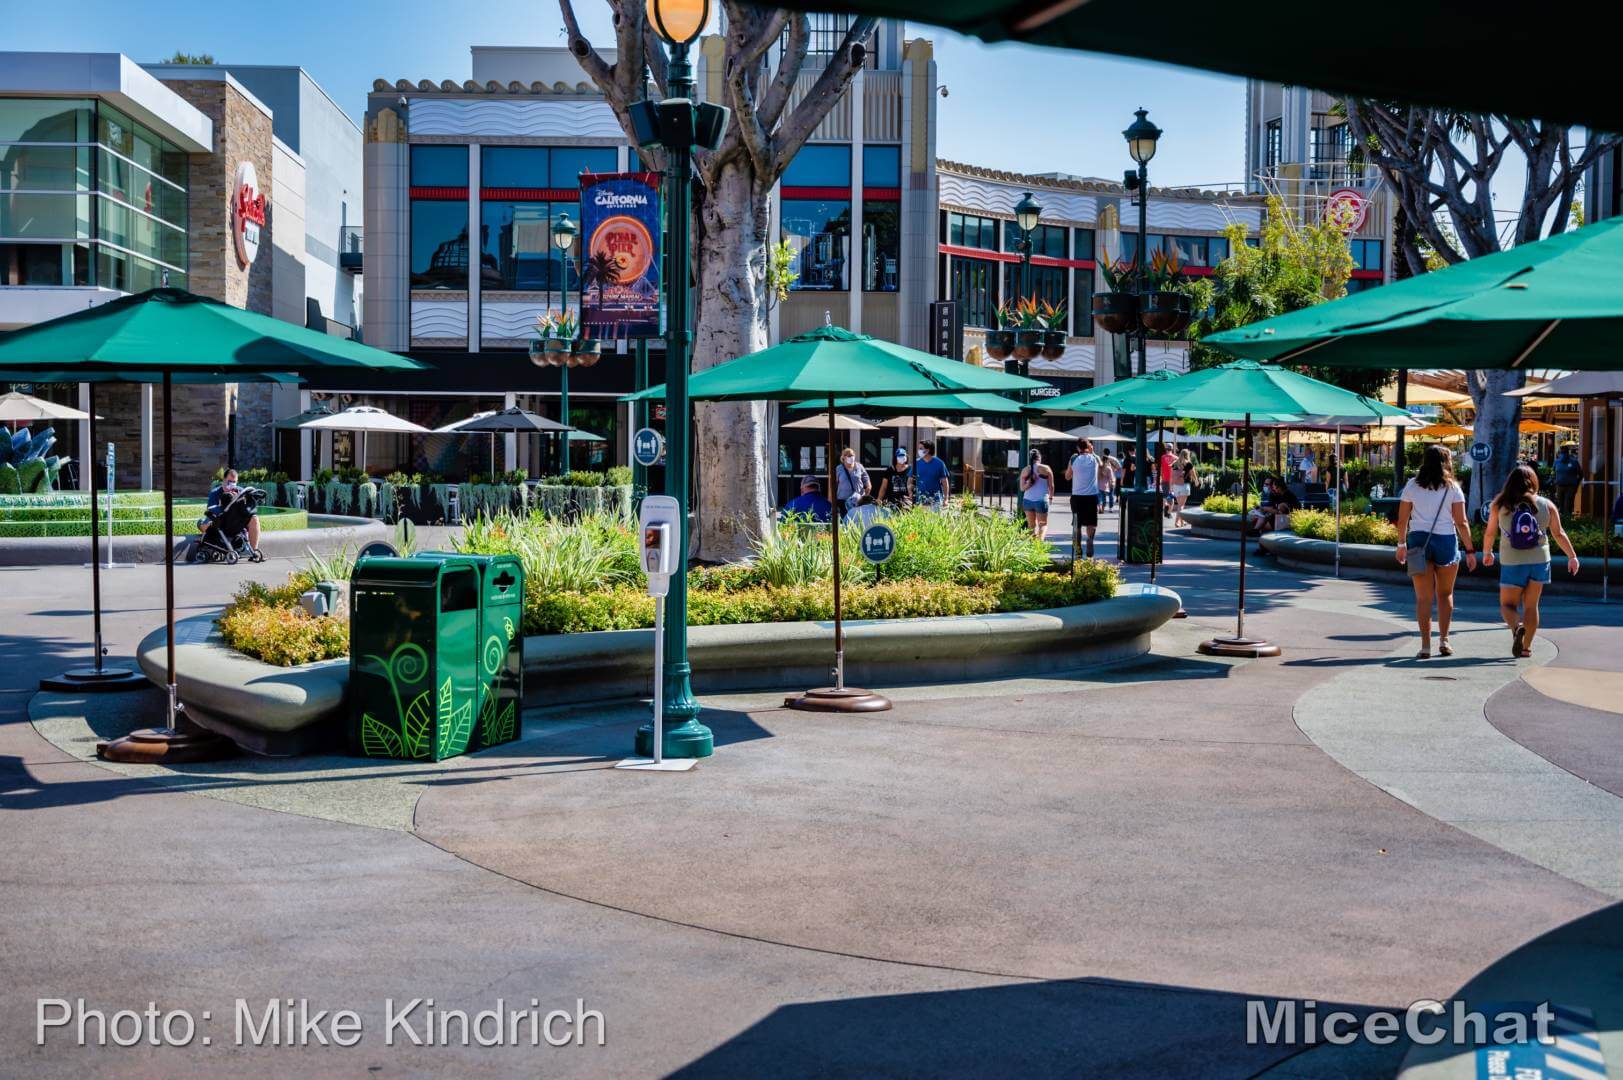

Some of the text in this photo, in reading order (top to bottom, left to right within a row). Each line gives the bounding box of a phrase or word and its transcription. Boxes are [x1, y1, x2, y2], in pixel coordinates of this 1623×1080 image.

[594, 194, 648, 206] CALIFORNIA
[608, 242, 636, 257] PIER
[1030, 387, 1061, 397] BURGERS
